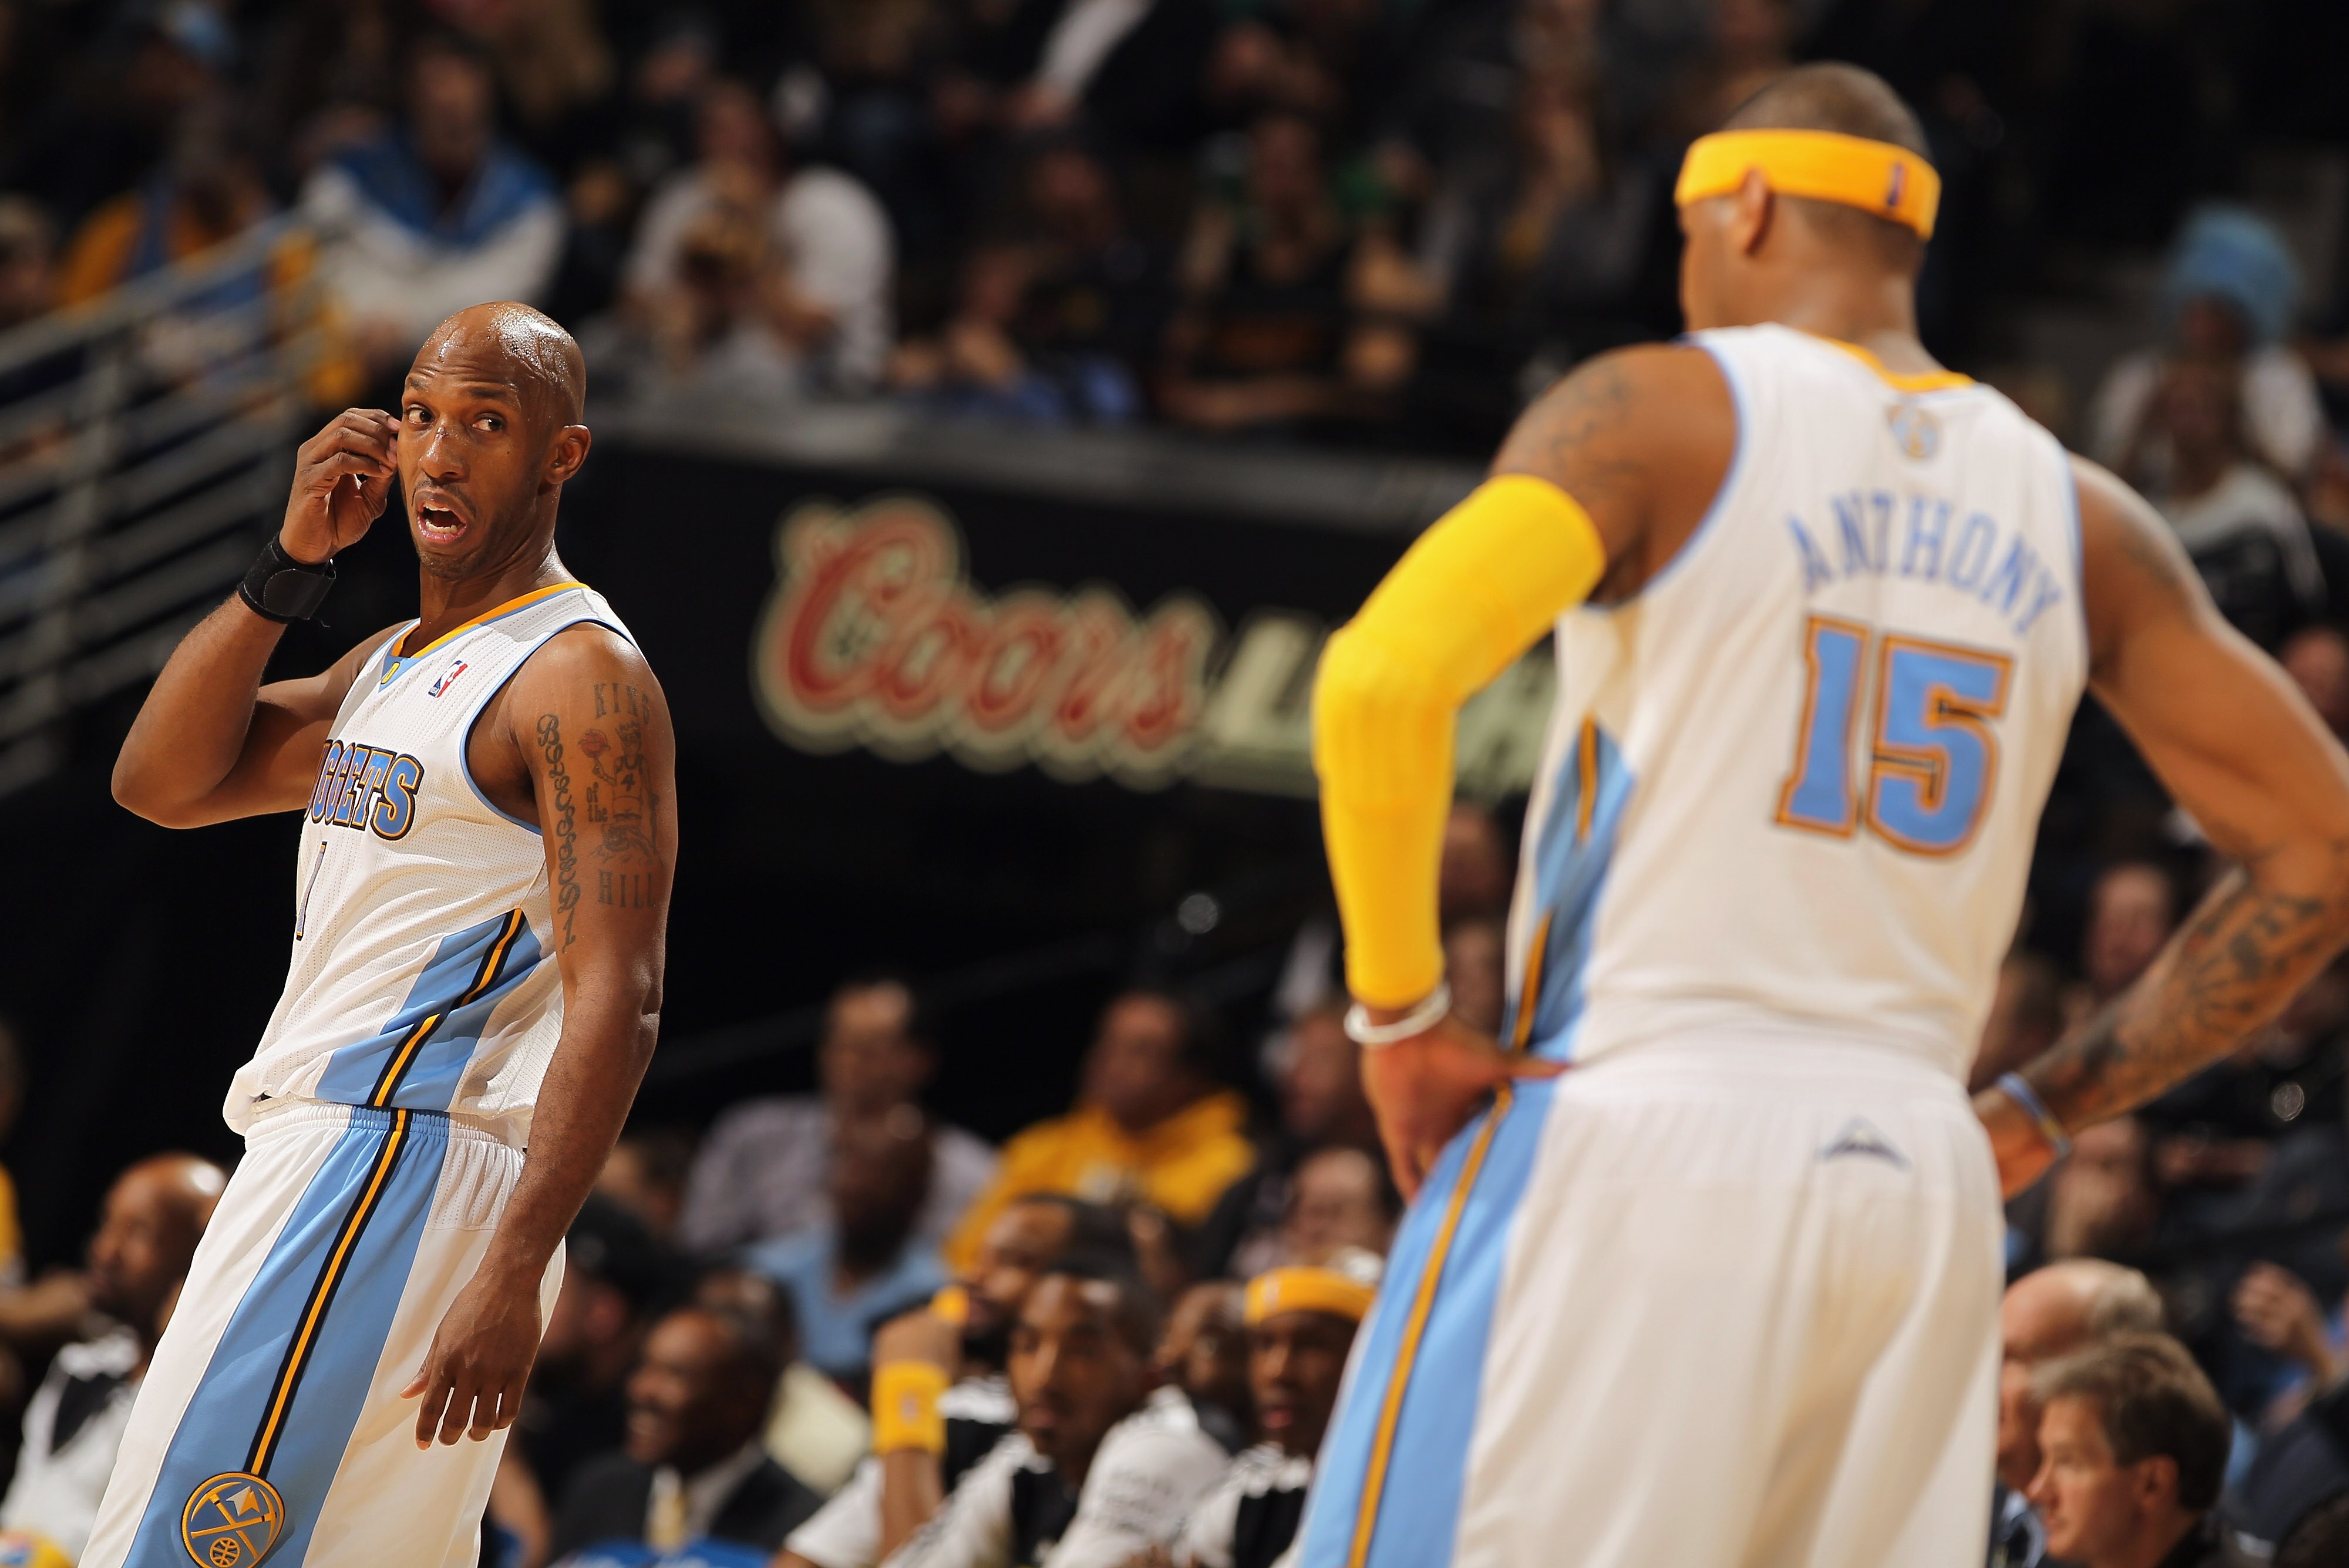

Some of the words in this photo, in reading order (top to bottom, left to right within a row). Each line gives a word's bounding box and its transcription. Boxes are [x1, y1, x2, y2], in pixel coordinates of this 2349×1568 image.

[758, 502, 1210, 784] Coors
[1786, 491, 2063, 637] ANTHONY
[1775, 614, 2013, 857] 15
